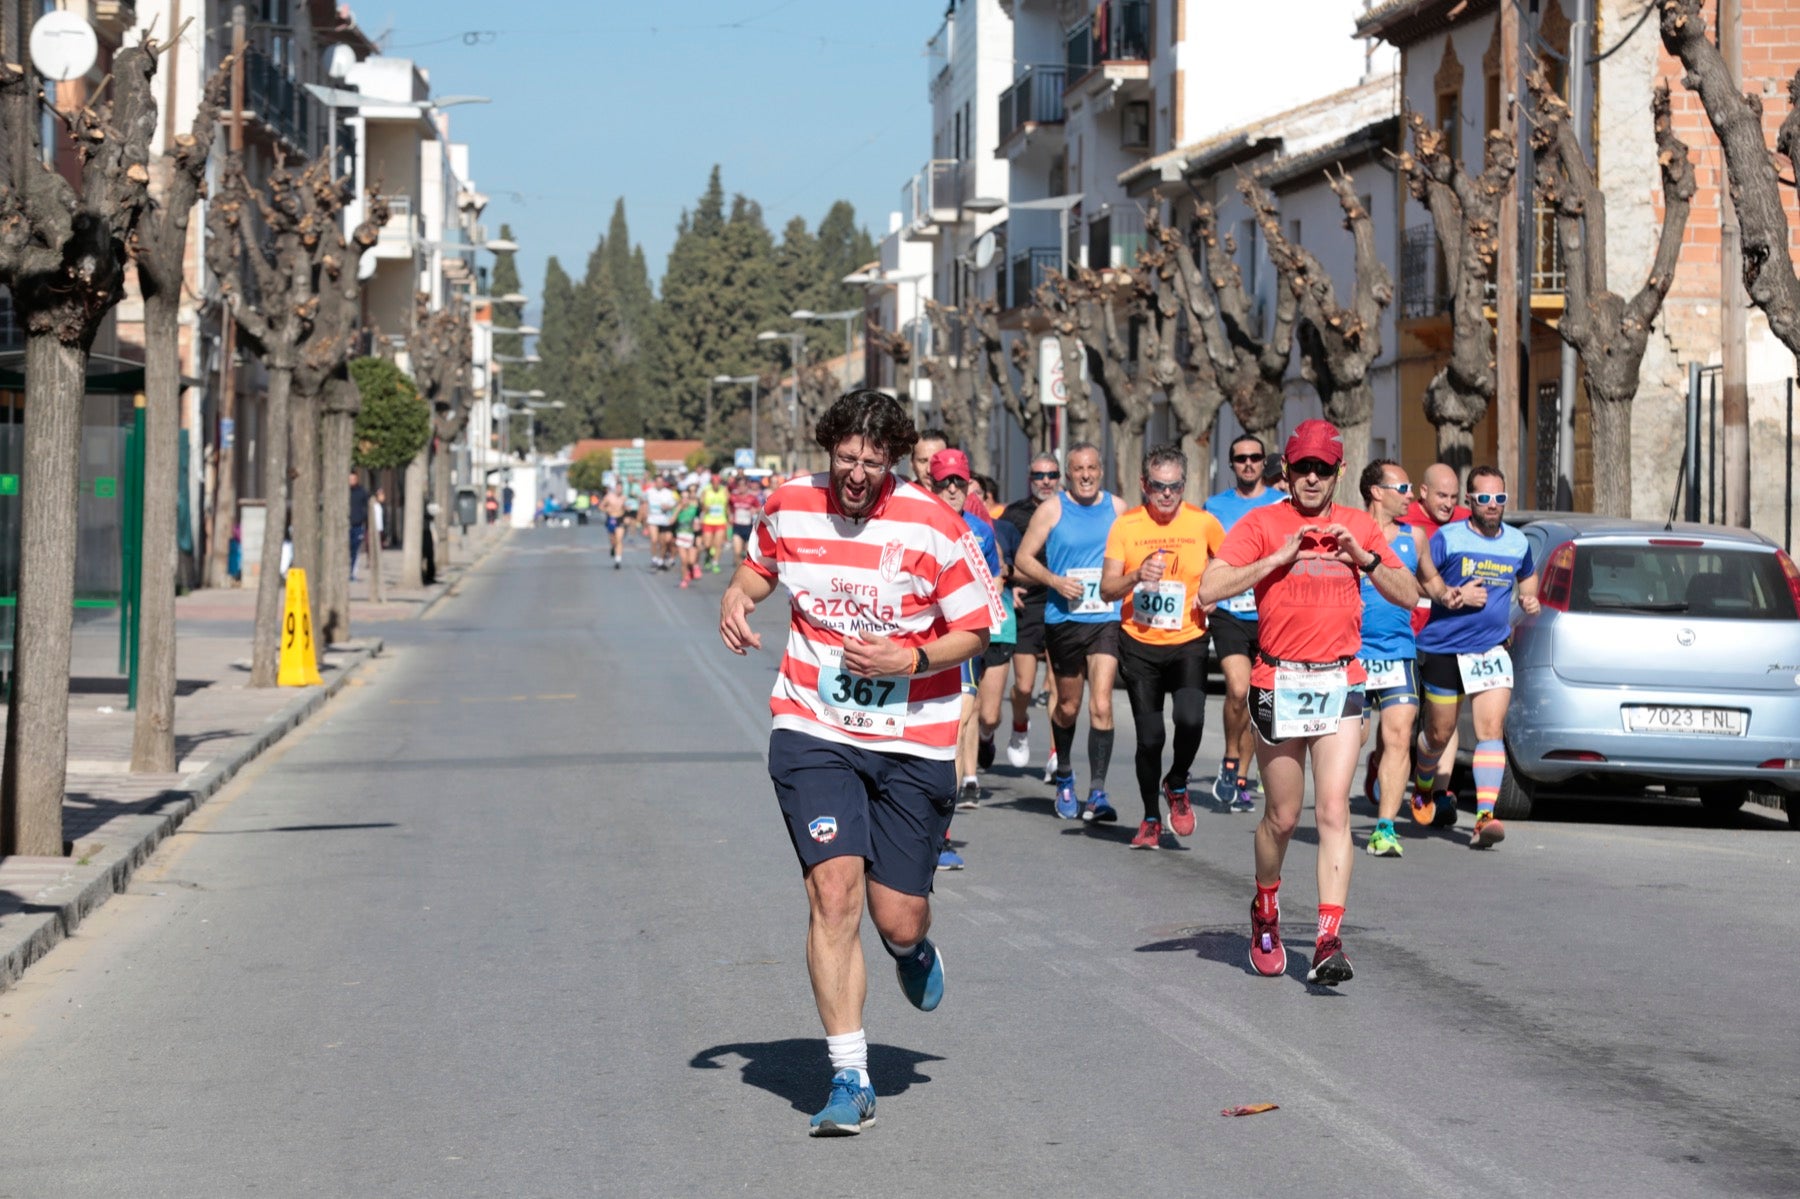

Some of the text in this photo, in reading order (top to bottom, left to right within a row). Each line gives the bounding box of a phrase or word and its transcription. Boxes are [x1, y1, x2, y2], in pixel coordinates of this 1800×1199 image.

[1477, 559, 1514, 574] olimpo
[831, 577, 878, 597] Sierra
[794, 590, 894, 622] Cazorla
[1140, 594, 1175, 613] 306
[286, 611, 296, 650] 9
[302, 612, 310, 651] 9
[1470, 658, 1504, 678] 451
[832, 673, 896, 708] 367
[1297, 692, 1330, 715] 27
[1647, 708, 1736, 730] 7023 FNL
